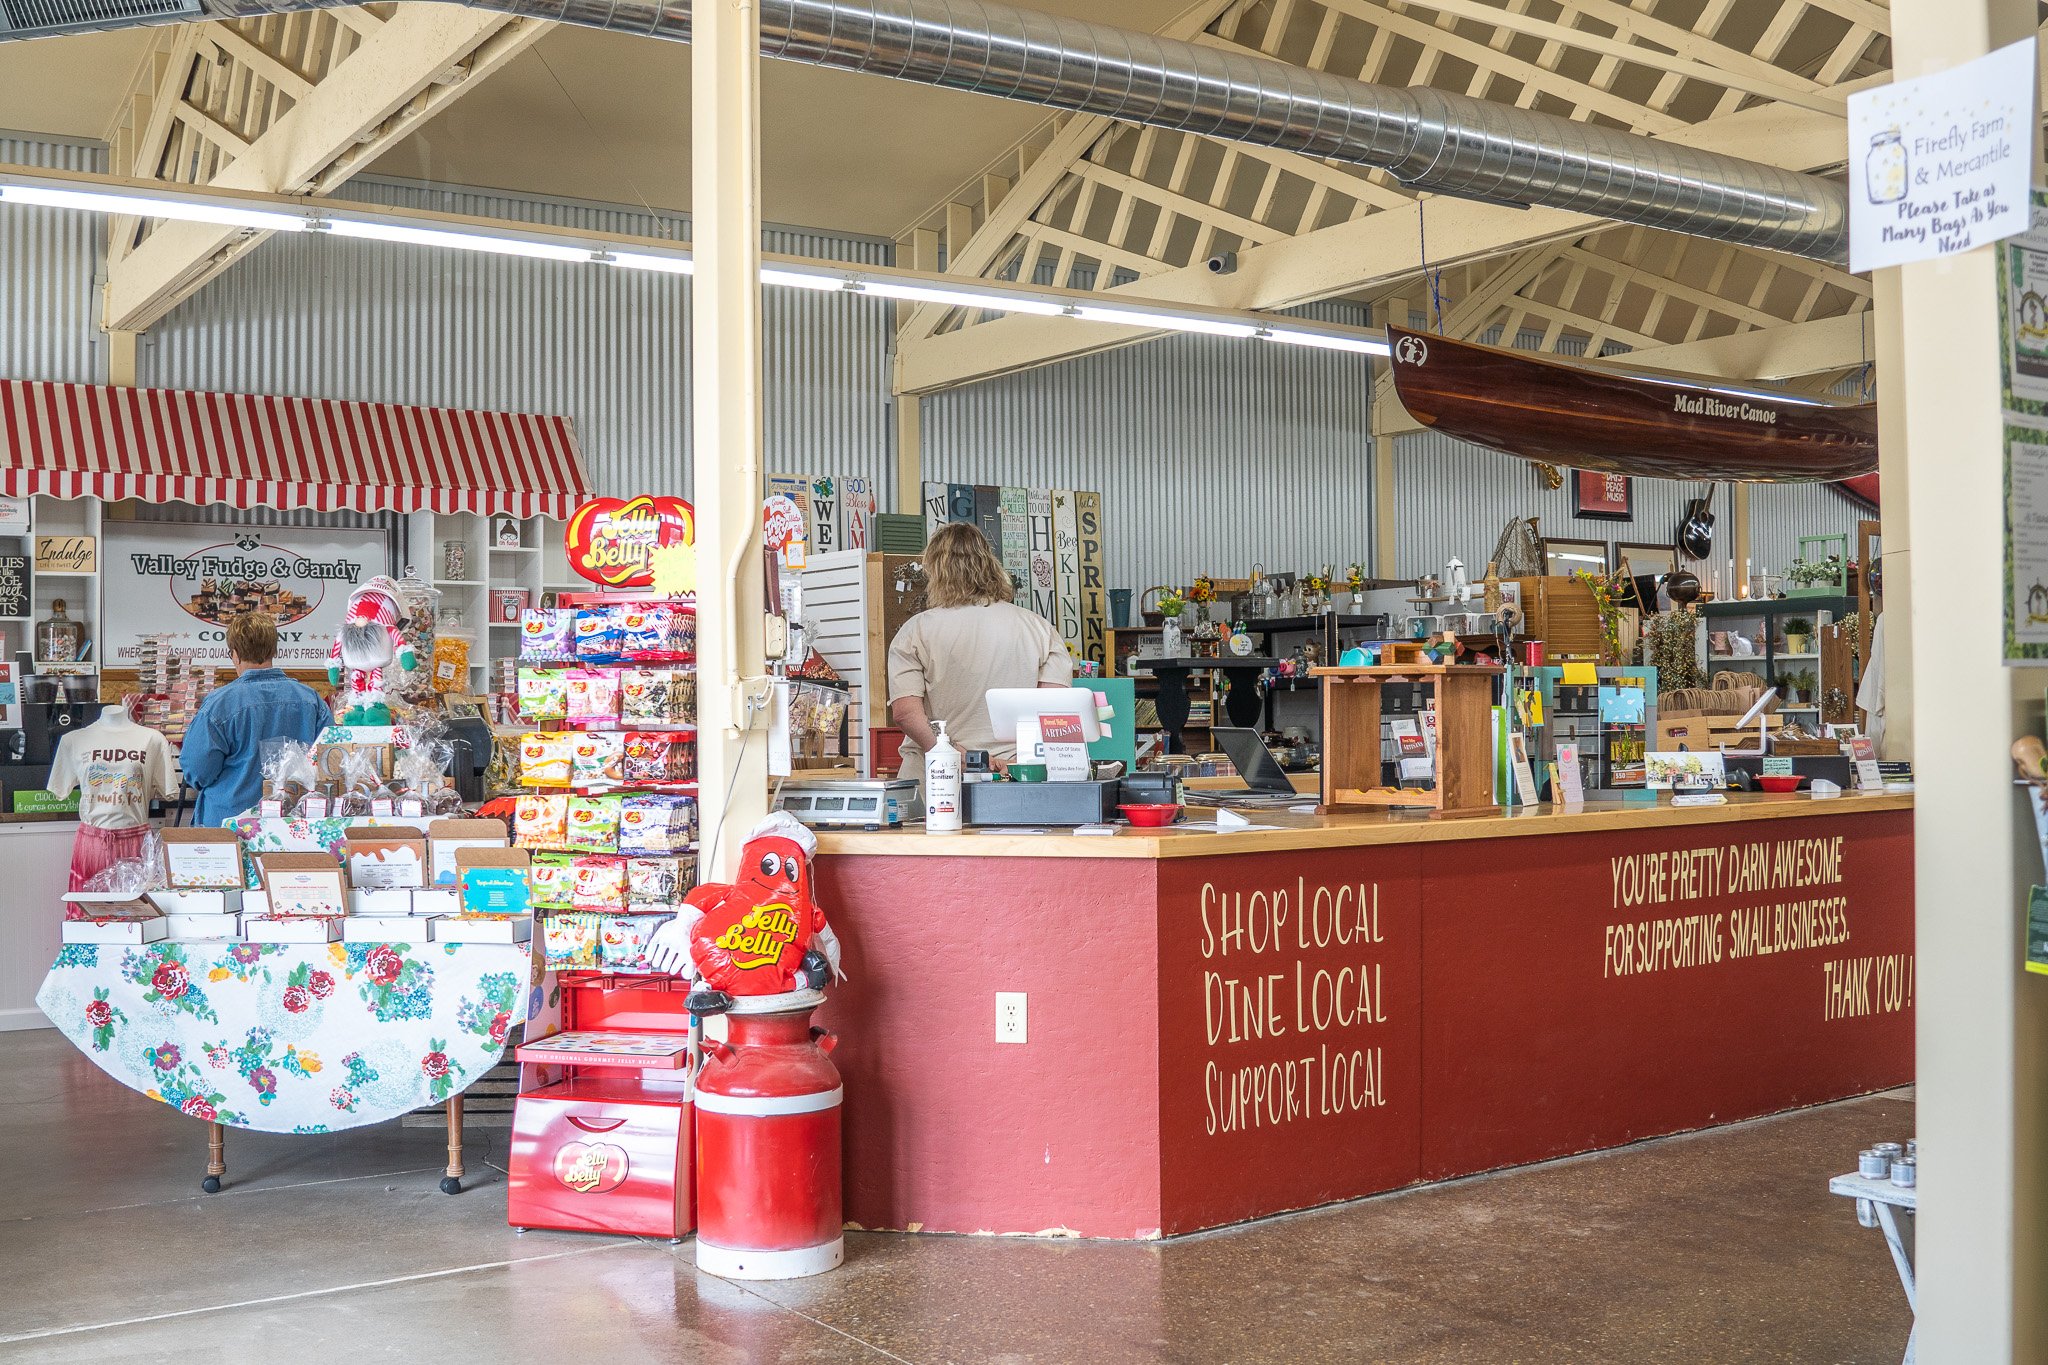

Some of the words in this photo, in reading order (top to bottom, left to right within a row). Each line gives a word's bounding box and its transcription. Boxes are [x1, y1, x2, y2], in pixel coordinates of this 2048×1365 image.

[1915, 125, 1967, 155] Firefly
[1972, 117, 2003, 140] Farm
[1915, 167, 1929, 185] &
[1937, 138, 2010, 181] Mercantile
[1898, 201, 1949, 219] Please
[1953, 188, 1980, 209] Take
[1983, 183, 1996, 196] as
[1882, 225, 1926, 243] Many
[1932, 216, 1966, 237] Bags
[1970, 207, 1984, 223] As
[1987, 200, 2010, 220] You
[1938, 231, 1971, 254] Need
[1674, 394, 1704, 414] Mad
[1705, 398, 1739, 418] River
[1741, 403, 1776, 424] Canoe
[846, 479, 866, 494] GOD
[846, 493, 867, 509] Bless
[1606, 482, 1625, 493] PEACE
[1606, 492, 1625, 503] MUSIC
[602, 497, 660, 544] Jelly
[1007, 503, 1026, 514] RULES
[1028, 502, 1037, 514] TO
[1037, 502, 1051, 514] OUR
[36, 538, 93, 570] Indulge
[1055, 530, 1078, 549] Bee
[131, 554, 199, 580] Valley
[203, 557, 267, 581] Fudge
[271, 558, 290, 579] &
[293, 559, 361, 584] Candy
[581, 537, 649, 584] Belly
[1018, 569, 1029, 577] THE
[1060, 553, 1079, 639] KIND
[1082, 511, 1106, 666] SPRING
[198, 631, 303, 642] CONY
[301, 648, 325, 659] FRESH
[1045, 723, 1082, 738] ARTISANS
[92, 749, 147, 764] FUDGE
[1611, 851, 1668, 909] YOU'RE
[1671, 846, 1725, 901] PRETTY
[1728, 842, 1769, 894] DARN
[1772, 836, 1843, 889] AWESOME
[742, 903, 798, 943] Jelly
[1201, 882, 1288, 959] SHOP
[1298, 876, 1384, 948] LOCAL
[716, 924, 784, 970] Belly
[1604, 923, 1634, 978] FOR
[1636, 913, 1723, 973] SUPPORTING
[1729, 905, 1773, 959] SMALL
[1774, 896, 1850, 952] BUSINESSES.
[1824, 956, 1872, 1021] THANK
[1876, 953, 1905, 1014] YOU
[1204, 971, 1286, 1046] DINE
[1297, 960, 1387, 1033] LOCAL
[1205, 1057, 1315, 1136] SUPPORT
[1322, 1044, 1386, 1115] LOCAL
[576, 1147, 608, 1171] Jelly
[564, 1165, 602, 1192] Belly
